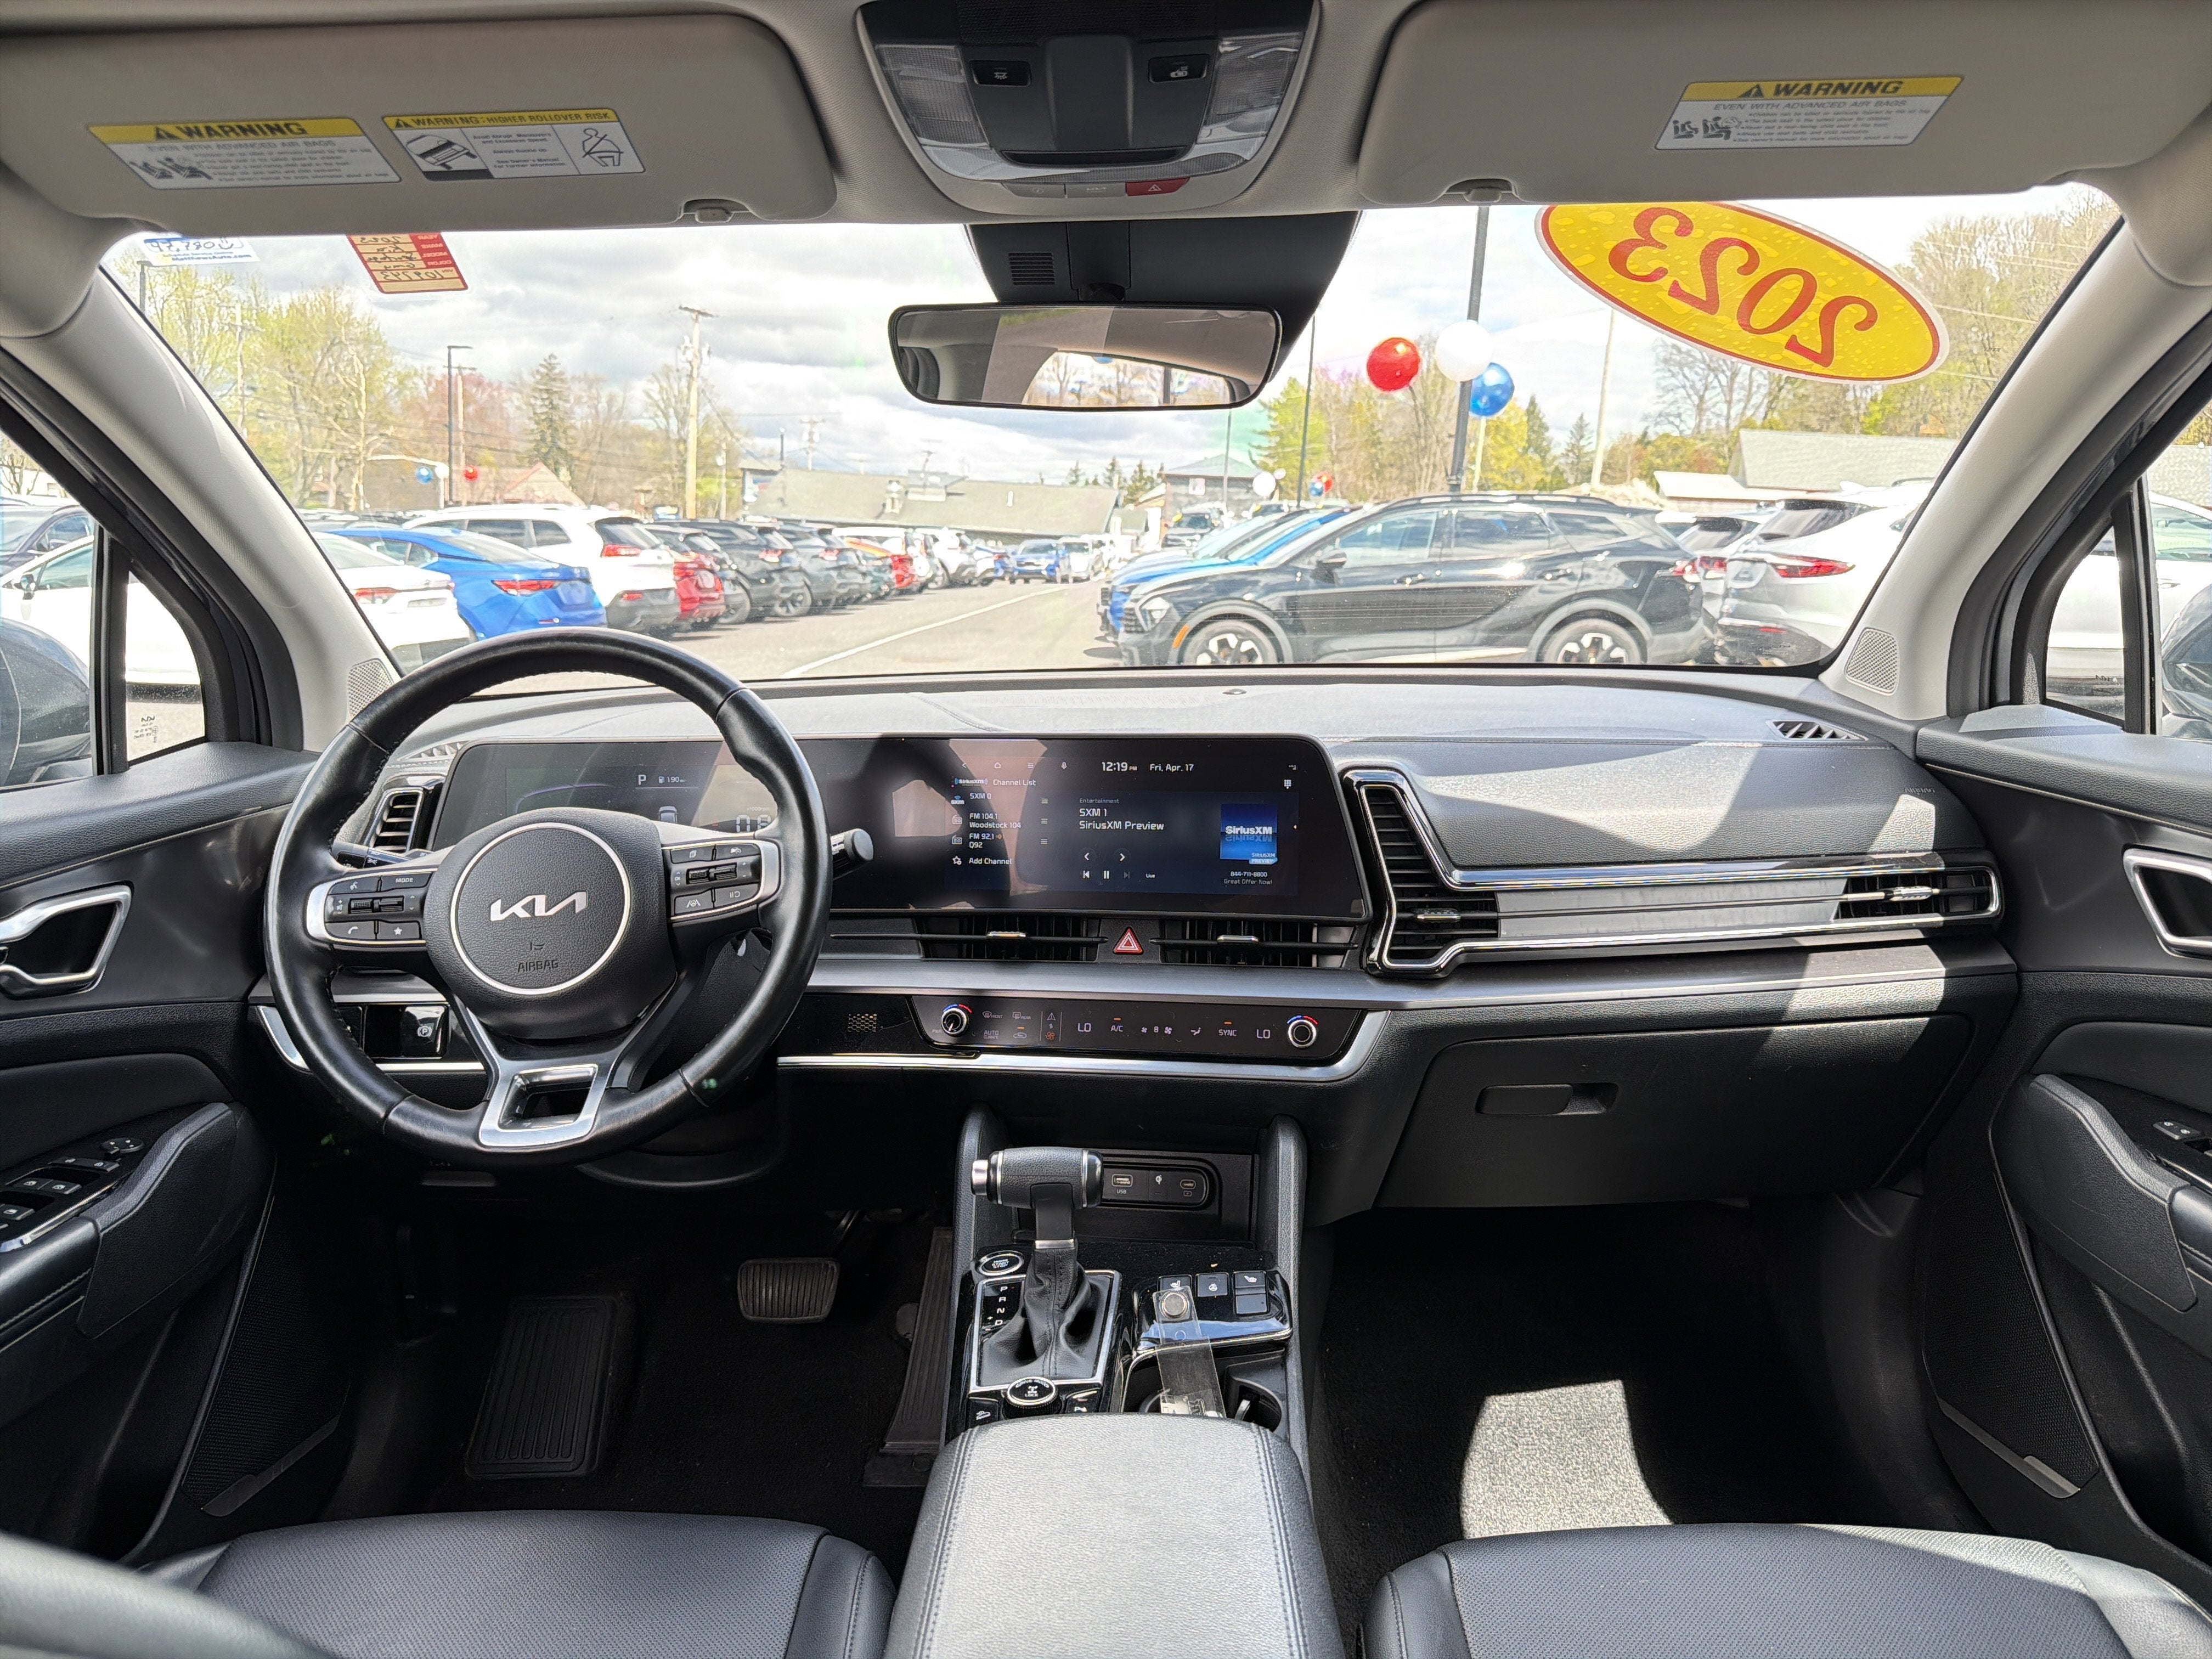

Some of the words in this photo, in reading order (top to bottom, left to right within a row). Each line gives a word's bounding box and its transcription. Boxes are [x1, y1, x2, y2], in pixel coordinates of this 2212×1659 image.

[1773, 81, 1903, 97] WARNING
[175, 122, 308, 138] WARNING
[1102, 761, 1128, 771] 12:19
[1165, 764, 1183, 773] Apr.
[638, 774, 647, 785] P
[1079, 808, 1101, 817] SXM
[1103, 809, 1107, 817] 1
[1079, 821, 1122, 830] SiriusXM
[1125, 821, 1165, 830] Preview
[1225, 826, 1273, 835] SiriusXM
[490, 891, 586, 922] KIA
[517, 960, 559, 973] AIRBAG
[1077, 1022, 1091, 1032] LO
[1218, 1029, 1237, 1037] SYNC
[1256, 1029, 1271, 1039] LO
